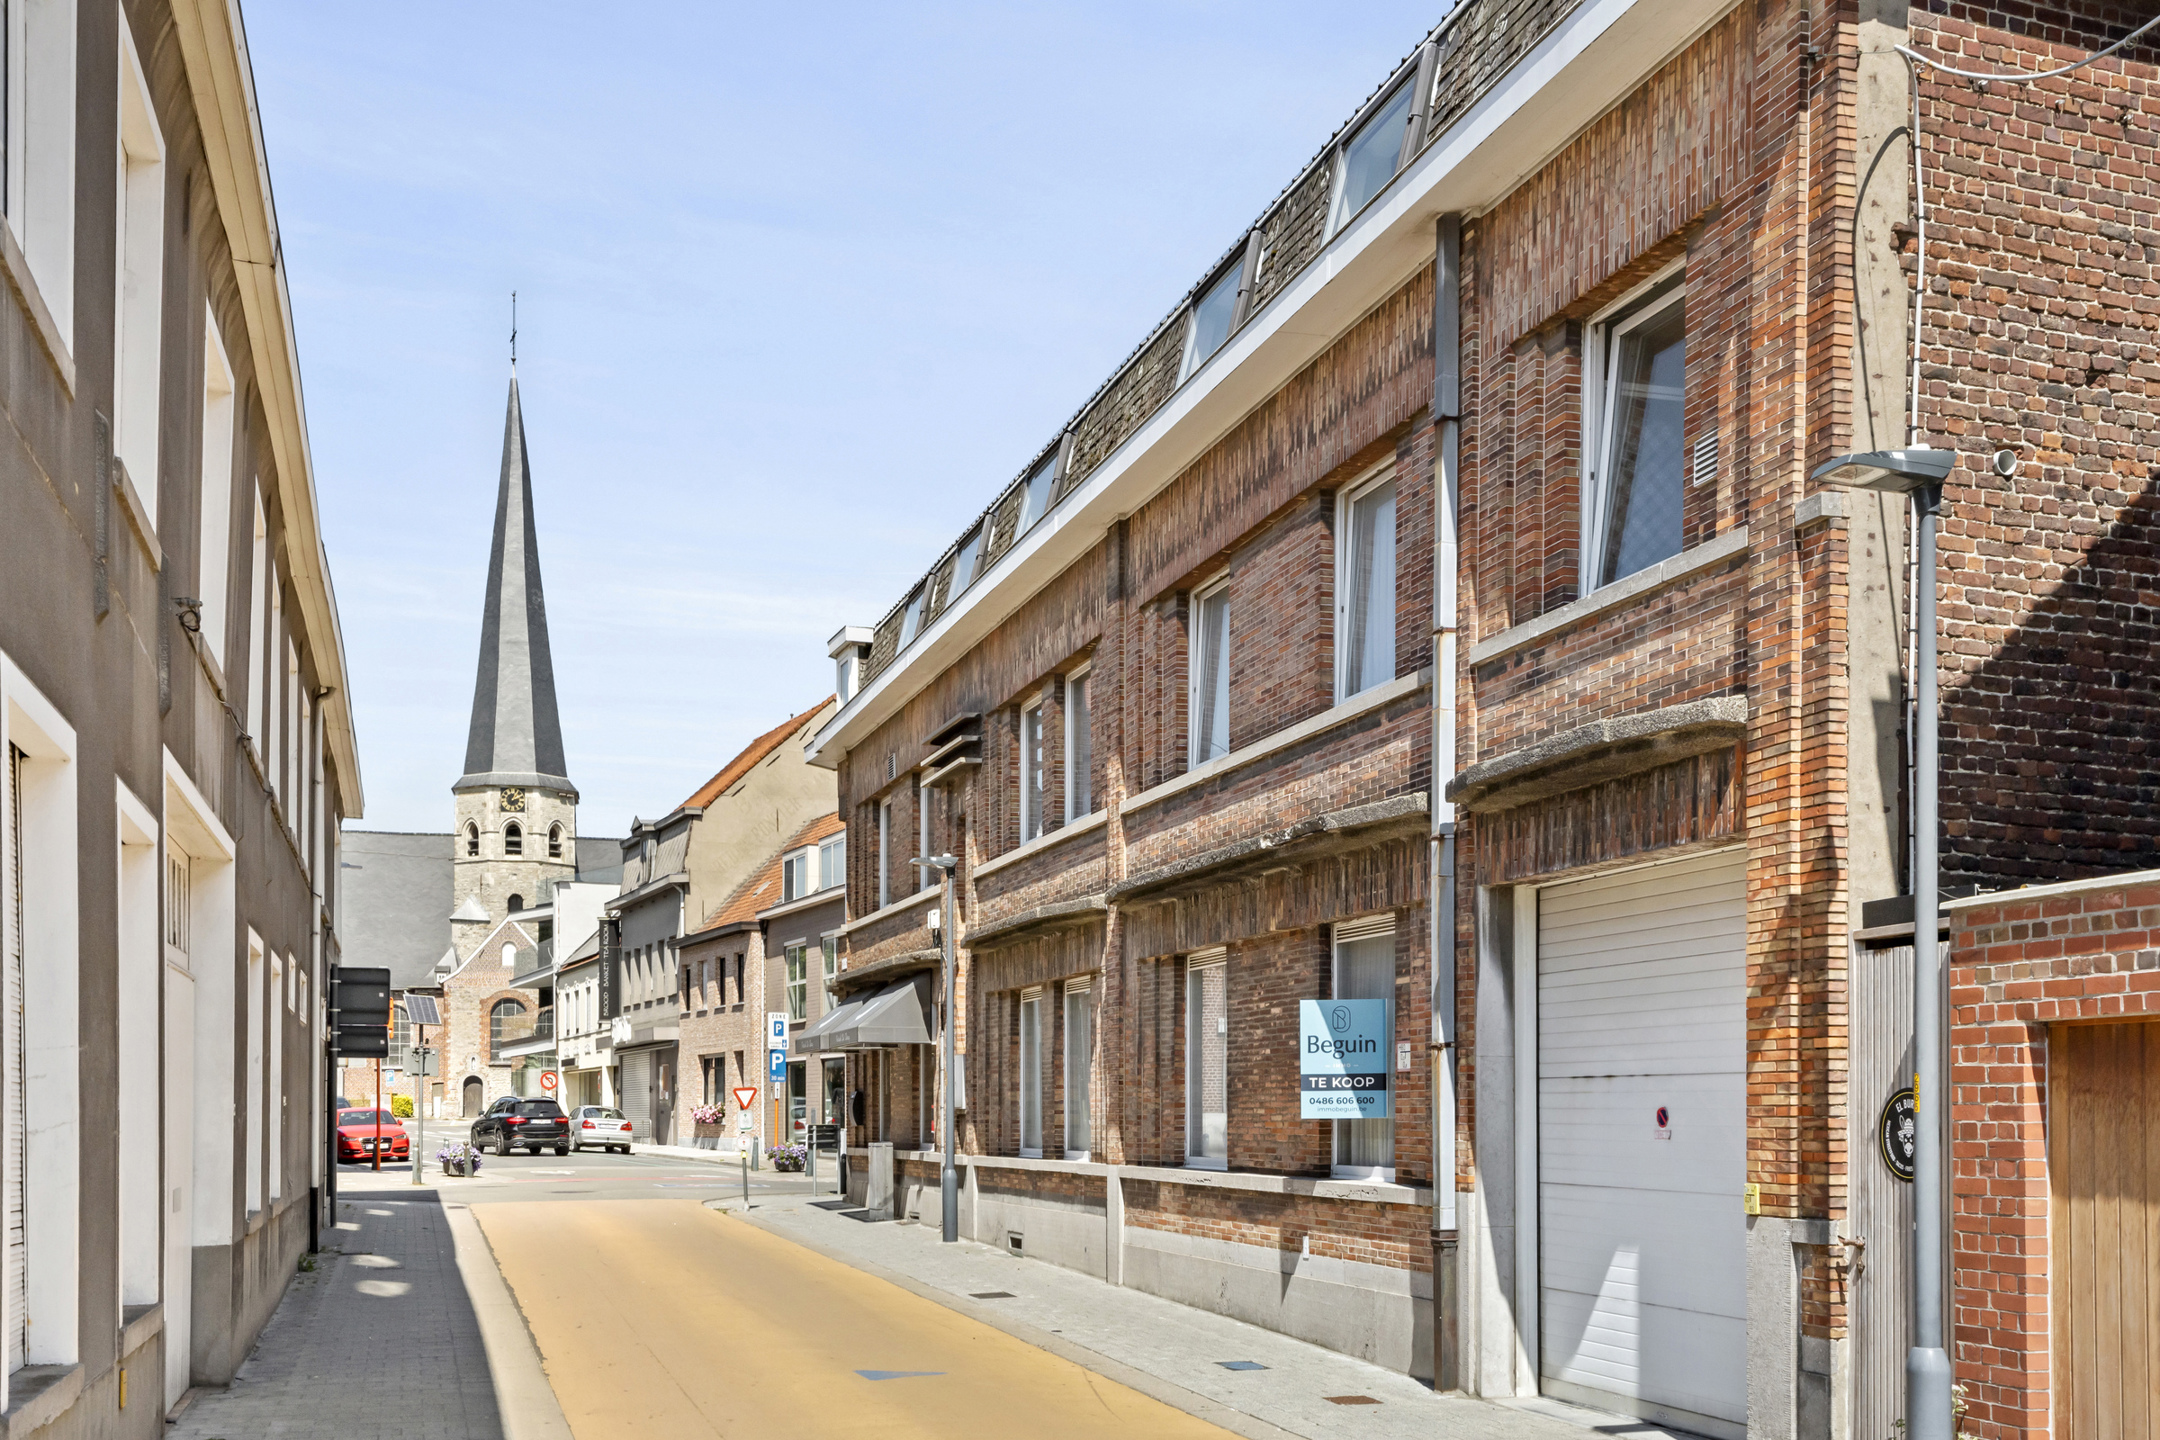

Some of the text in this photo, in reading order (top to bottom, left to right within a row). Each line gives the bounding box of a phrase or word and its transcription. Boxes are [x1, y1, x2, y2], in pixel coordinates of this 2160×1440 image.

[776, 1024, 782, 1034] P
[1308, 1034, 1376, 1060] Beguin
[772, 1053, 784, 1070] P
[1309, 1077, 1375, 1088] TE KOOP
[1309, 1097, 1334, 1105] 0486
[1895, 1099, 1914, 1112] EL BUR
